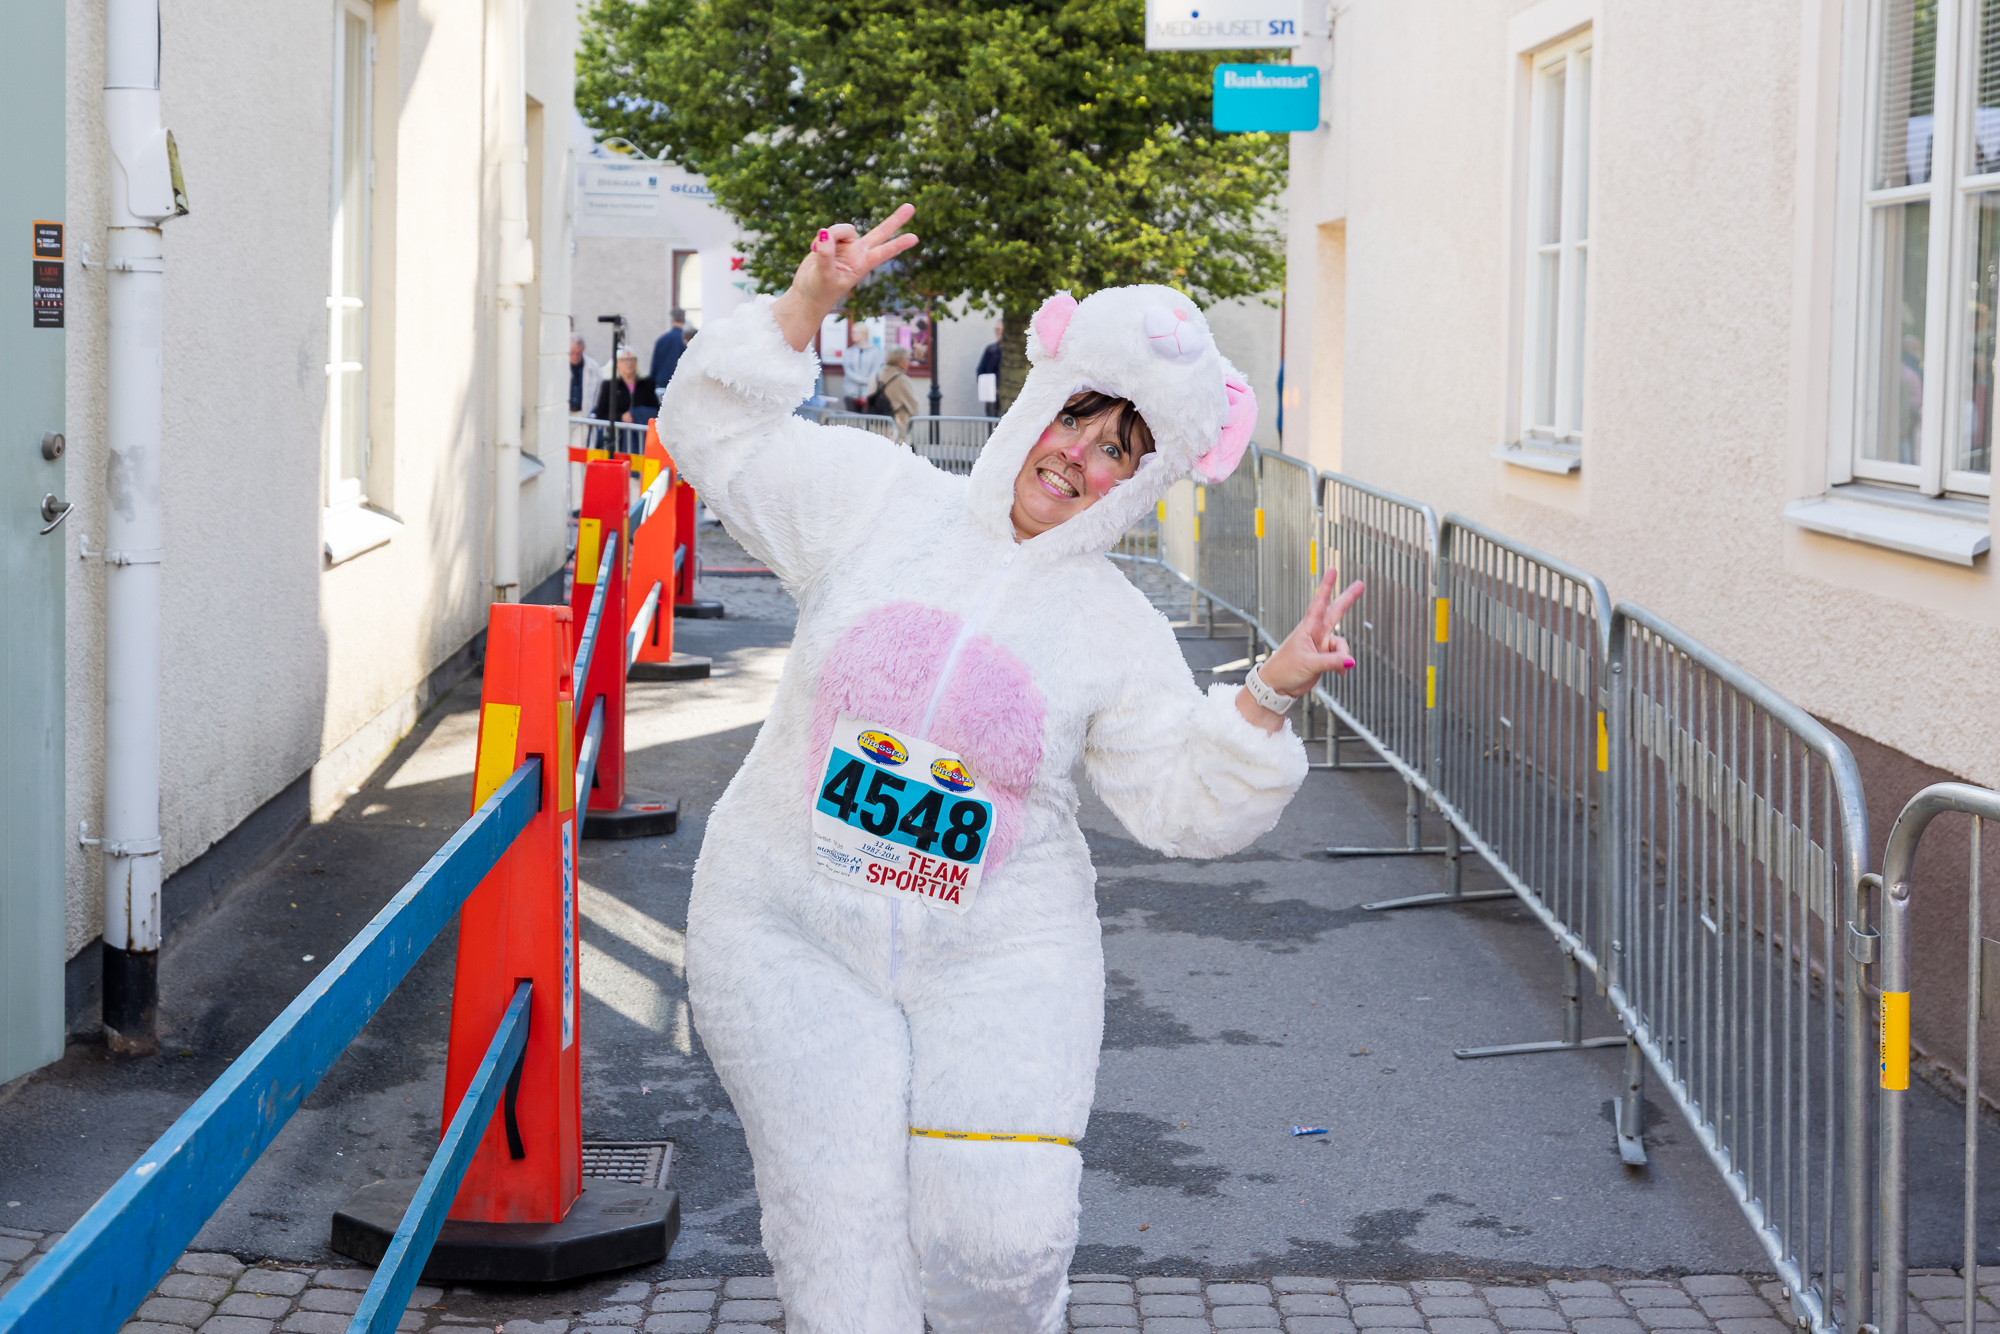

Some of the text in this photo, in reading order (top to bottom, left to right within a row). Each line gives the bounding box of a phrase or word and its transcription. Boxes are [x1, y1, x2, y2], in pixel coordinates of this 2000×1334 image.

[1154, 19, 1262, 37] MEDIEHUSET
[39, 266, 58, 276] LARM
[867, 733, 876, 742] ICA
[861, 736, 906, 761] TROSSEN
[933, 764, 974, 785] TROSSEN
[938, 761, 948, 770] ICA
[822, 758, 988, 862] 4548
[861, 843, 901, 862] 1987-2018
[874, 840, 895, 852] 32 år
[908, 851, 970, 887] TEAM
[866, 863, 960, 905] SPORTIA
